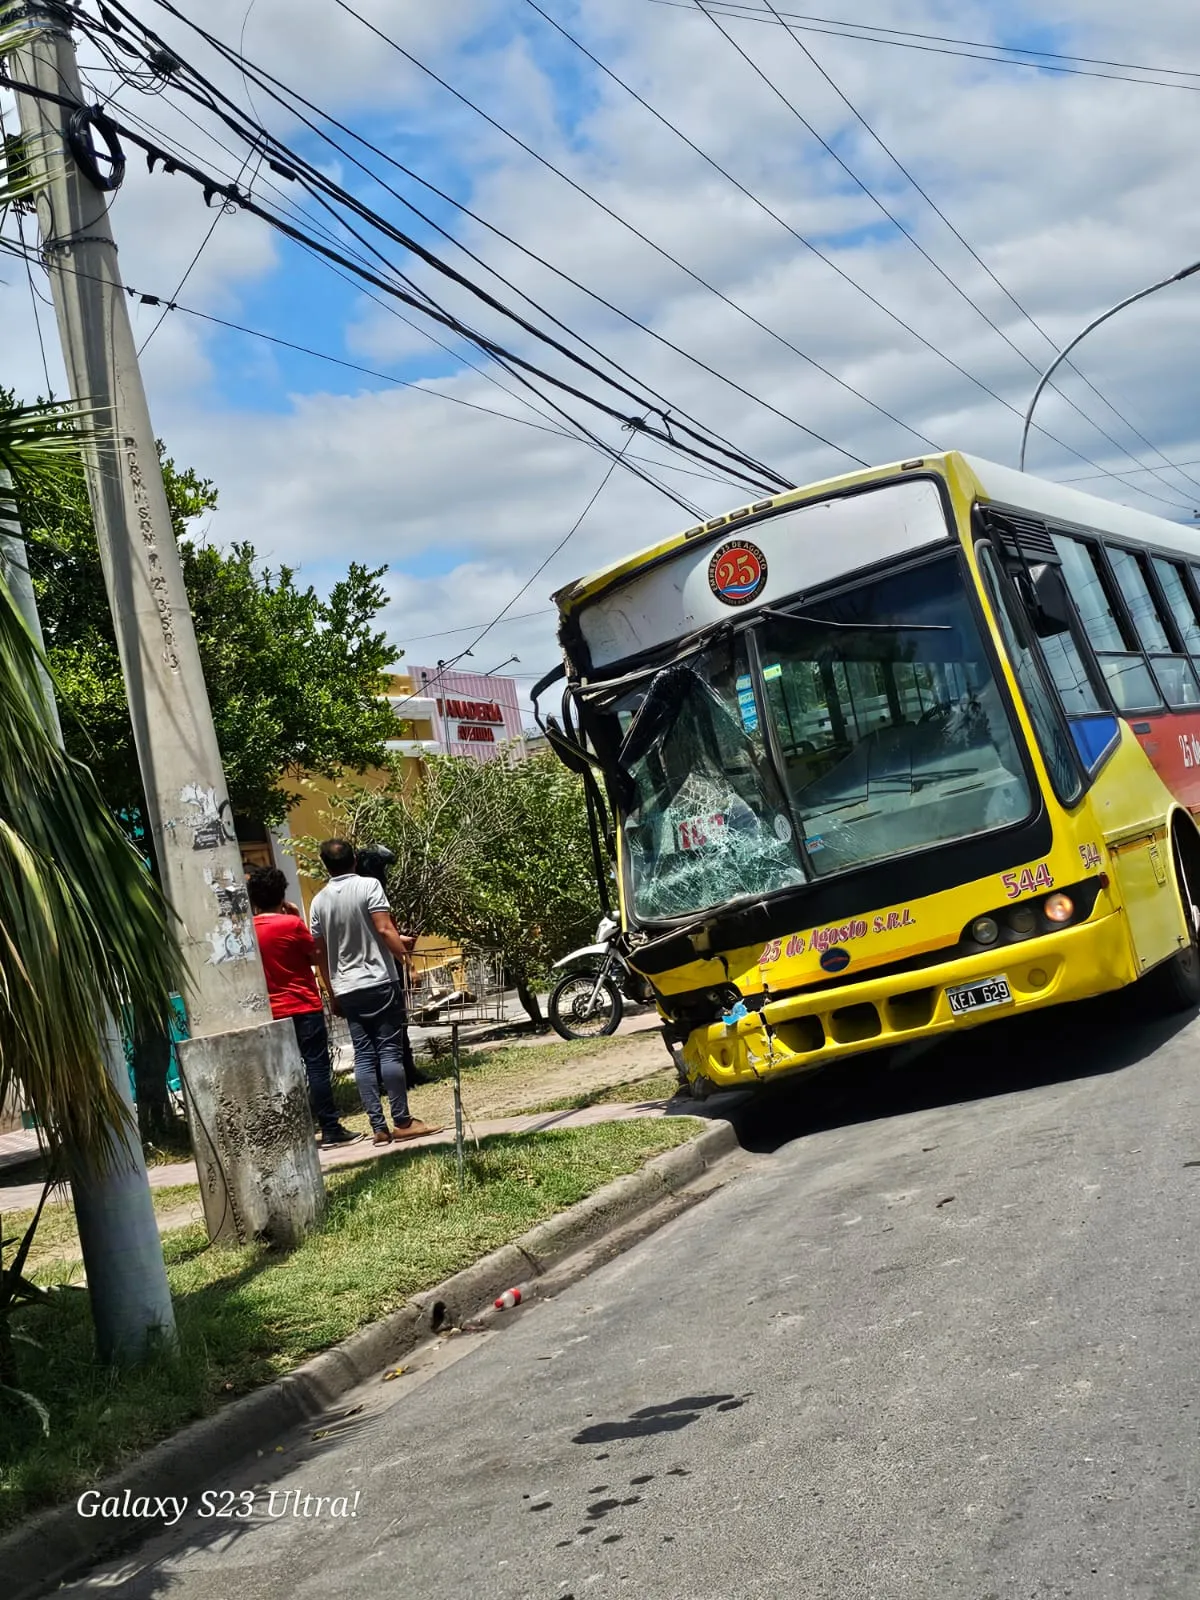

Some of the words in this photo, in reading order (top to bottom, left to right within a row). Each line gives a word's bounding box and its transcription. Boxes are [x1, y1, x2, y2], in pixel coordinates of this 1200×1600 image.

[709, 552, 721, 591] EMPRESA
[743, 542, 767, 570] AGOSTO
[719, 554, 755, 587] 25
[1178, 734, 1194, 768] 25
[1078, 842, 1102, 869] 544
[1001, 863, 1054, 898] 544
[757, 938, 783, 965] 25
[786, 935, 805, 957] de
[809, 920, 868, 953] Agosto
[872, 909, 917, 933] S.R.L.
[950, 992, 977, 1012] KEA
[982, 982, 1009, 1003] 629
